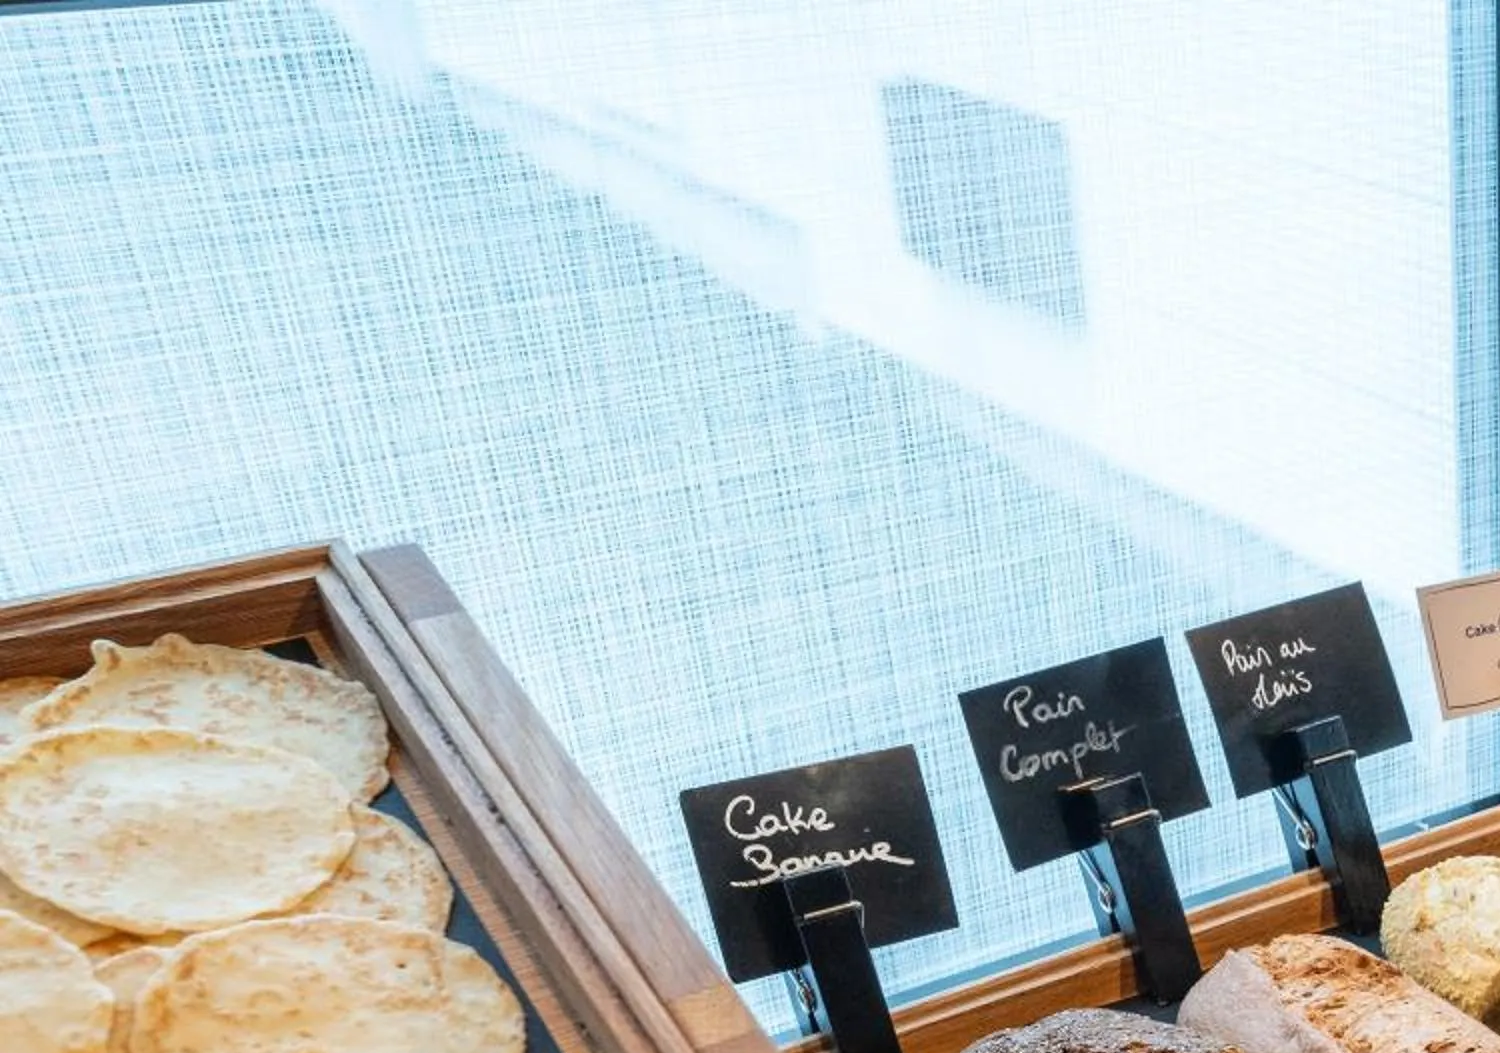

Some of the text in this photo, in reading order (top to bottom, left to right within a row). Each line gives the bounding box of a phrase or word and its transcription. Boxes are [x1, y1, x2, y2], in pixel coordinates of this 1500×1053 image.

[1221, 637, 1316, 677] Pain au
[1003, 685, 1085, 728] Pain
[1000, 720, 1138, 783] Complet
[725, 795, 835, 840] Cake
[730, 841, 915, 886] Banane
